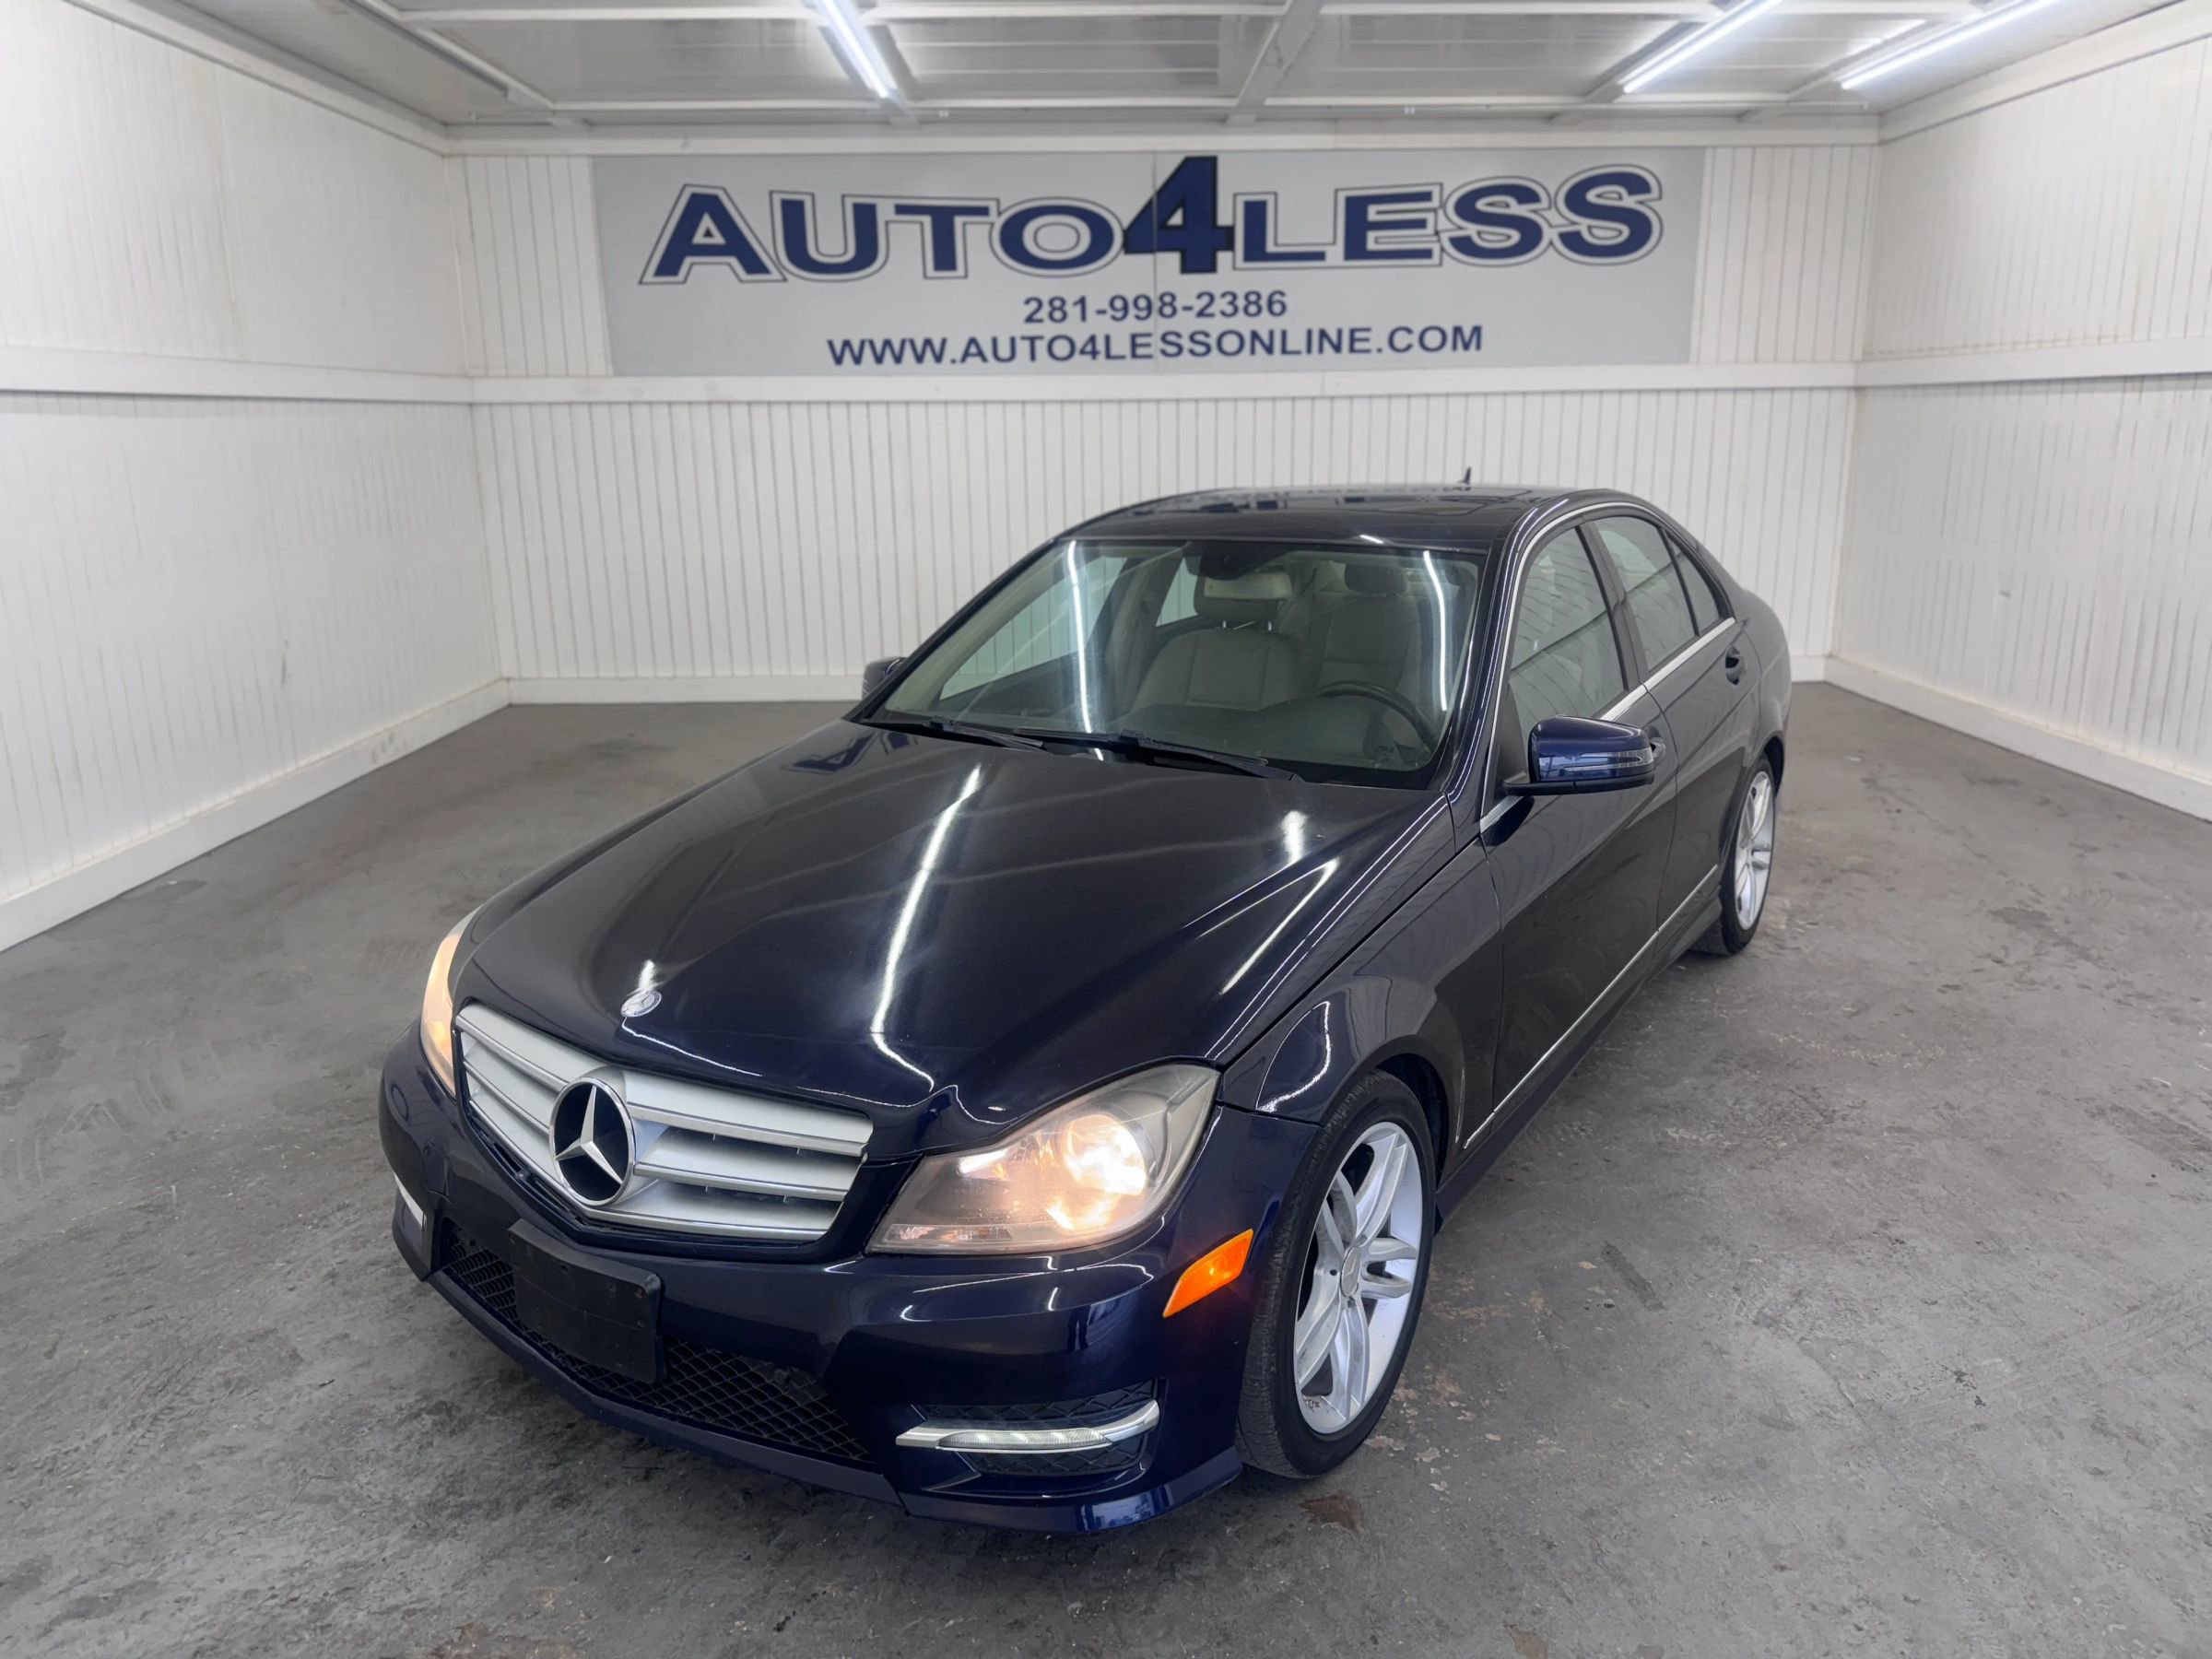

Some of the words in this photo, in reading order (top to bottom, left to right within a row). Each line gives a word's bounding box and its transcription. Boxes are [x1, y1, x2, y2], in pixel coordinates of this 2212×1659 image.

[640, 156, 1663, 284] AUTO4LESS
[1024, 290, 1288, 324] 281-998-2386
[827, 325, 1483, 366] WWW.AUTO4LESSONLINE.COM
